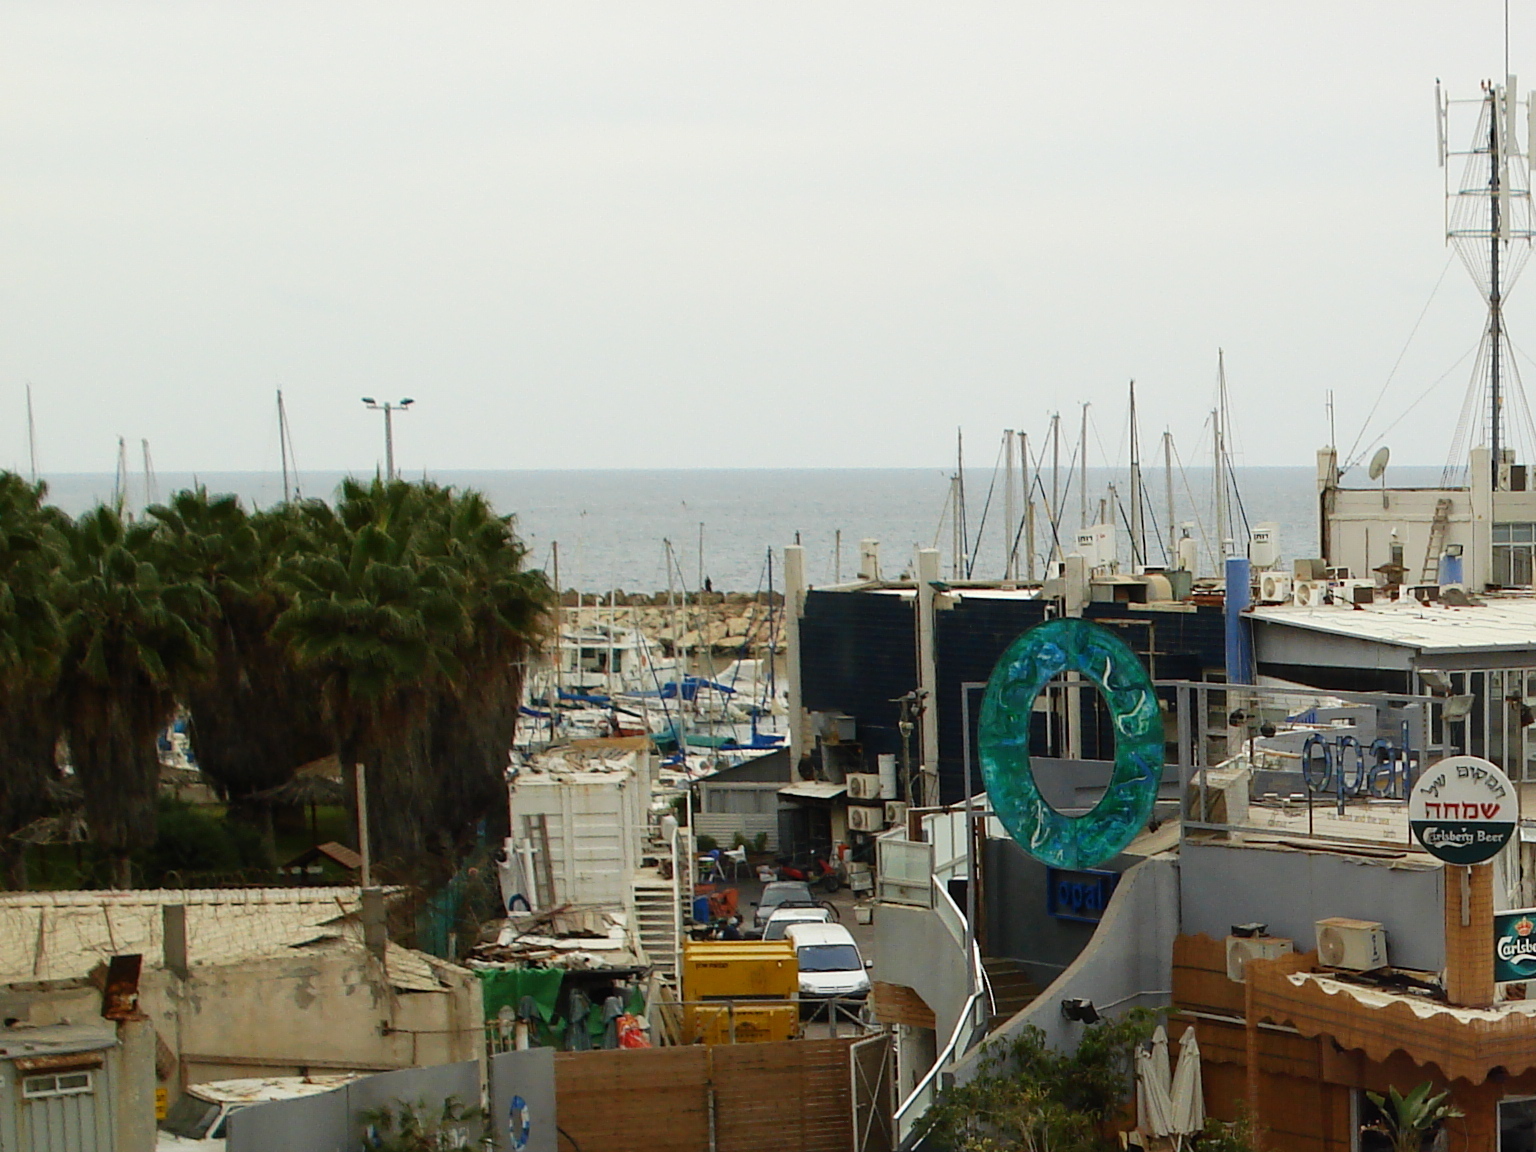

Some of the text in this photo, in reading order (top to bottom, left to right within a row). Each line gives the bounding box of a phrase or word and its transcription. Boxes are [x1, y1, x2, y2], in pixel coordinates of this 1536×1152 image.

[1302, 720, 1411, 815] opal
[1420, 764, 1507, 799] המקום של
[1424, 801, 1501, 820] שמחה
[1422, 827, 1504, 848] Carlsberg Beer
[1059, 878, 1103, 913] opal
